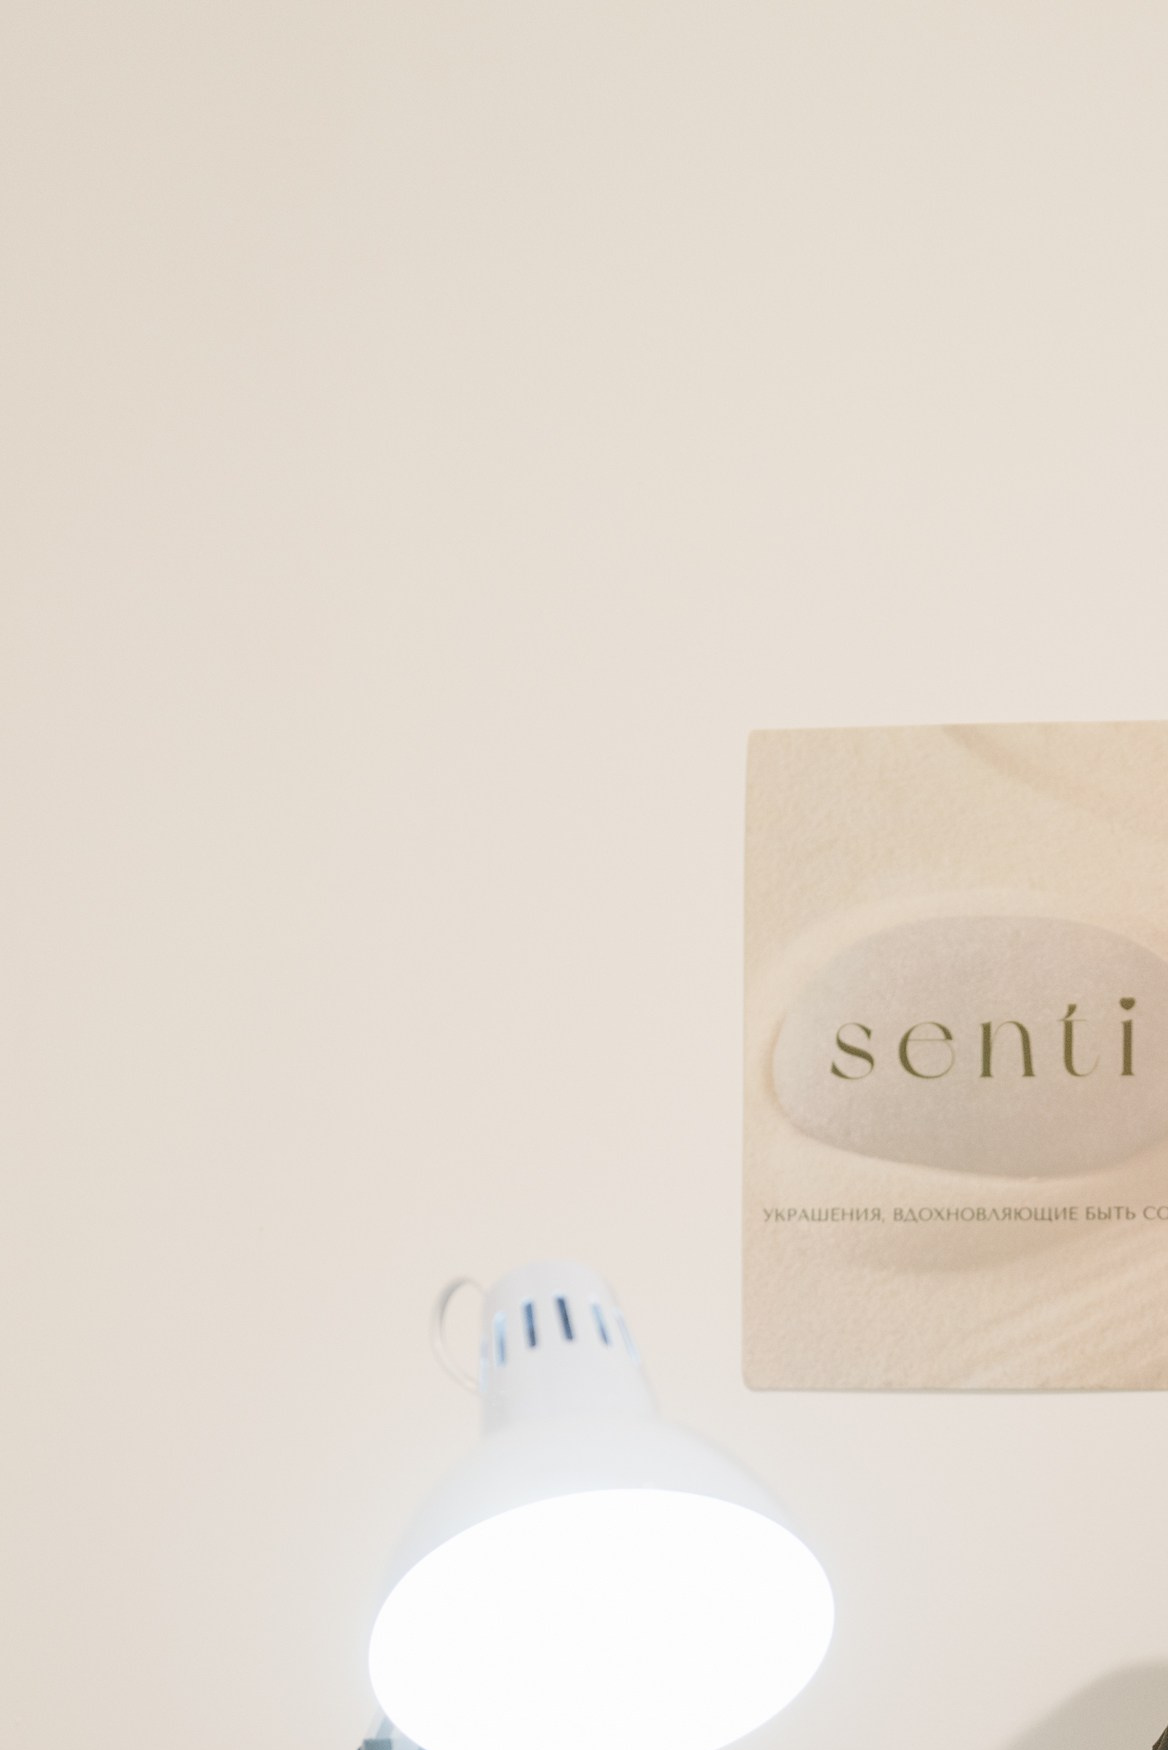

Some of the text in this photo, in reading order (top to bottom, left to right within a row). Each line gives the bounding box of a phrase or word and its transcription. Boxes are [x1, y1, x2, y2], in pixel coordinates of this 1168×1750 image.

[763, 1207, 886, 1223] УКРАШЕНИЯ,
[893, 1206, 1079, 1222] ВДОХНОВЛЯЮЩИЕ
[1085, 1206, 1137, 1221] БЫТЬ
